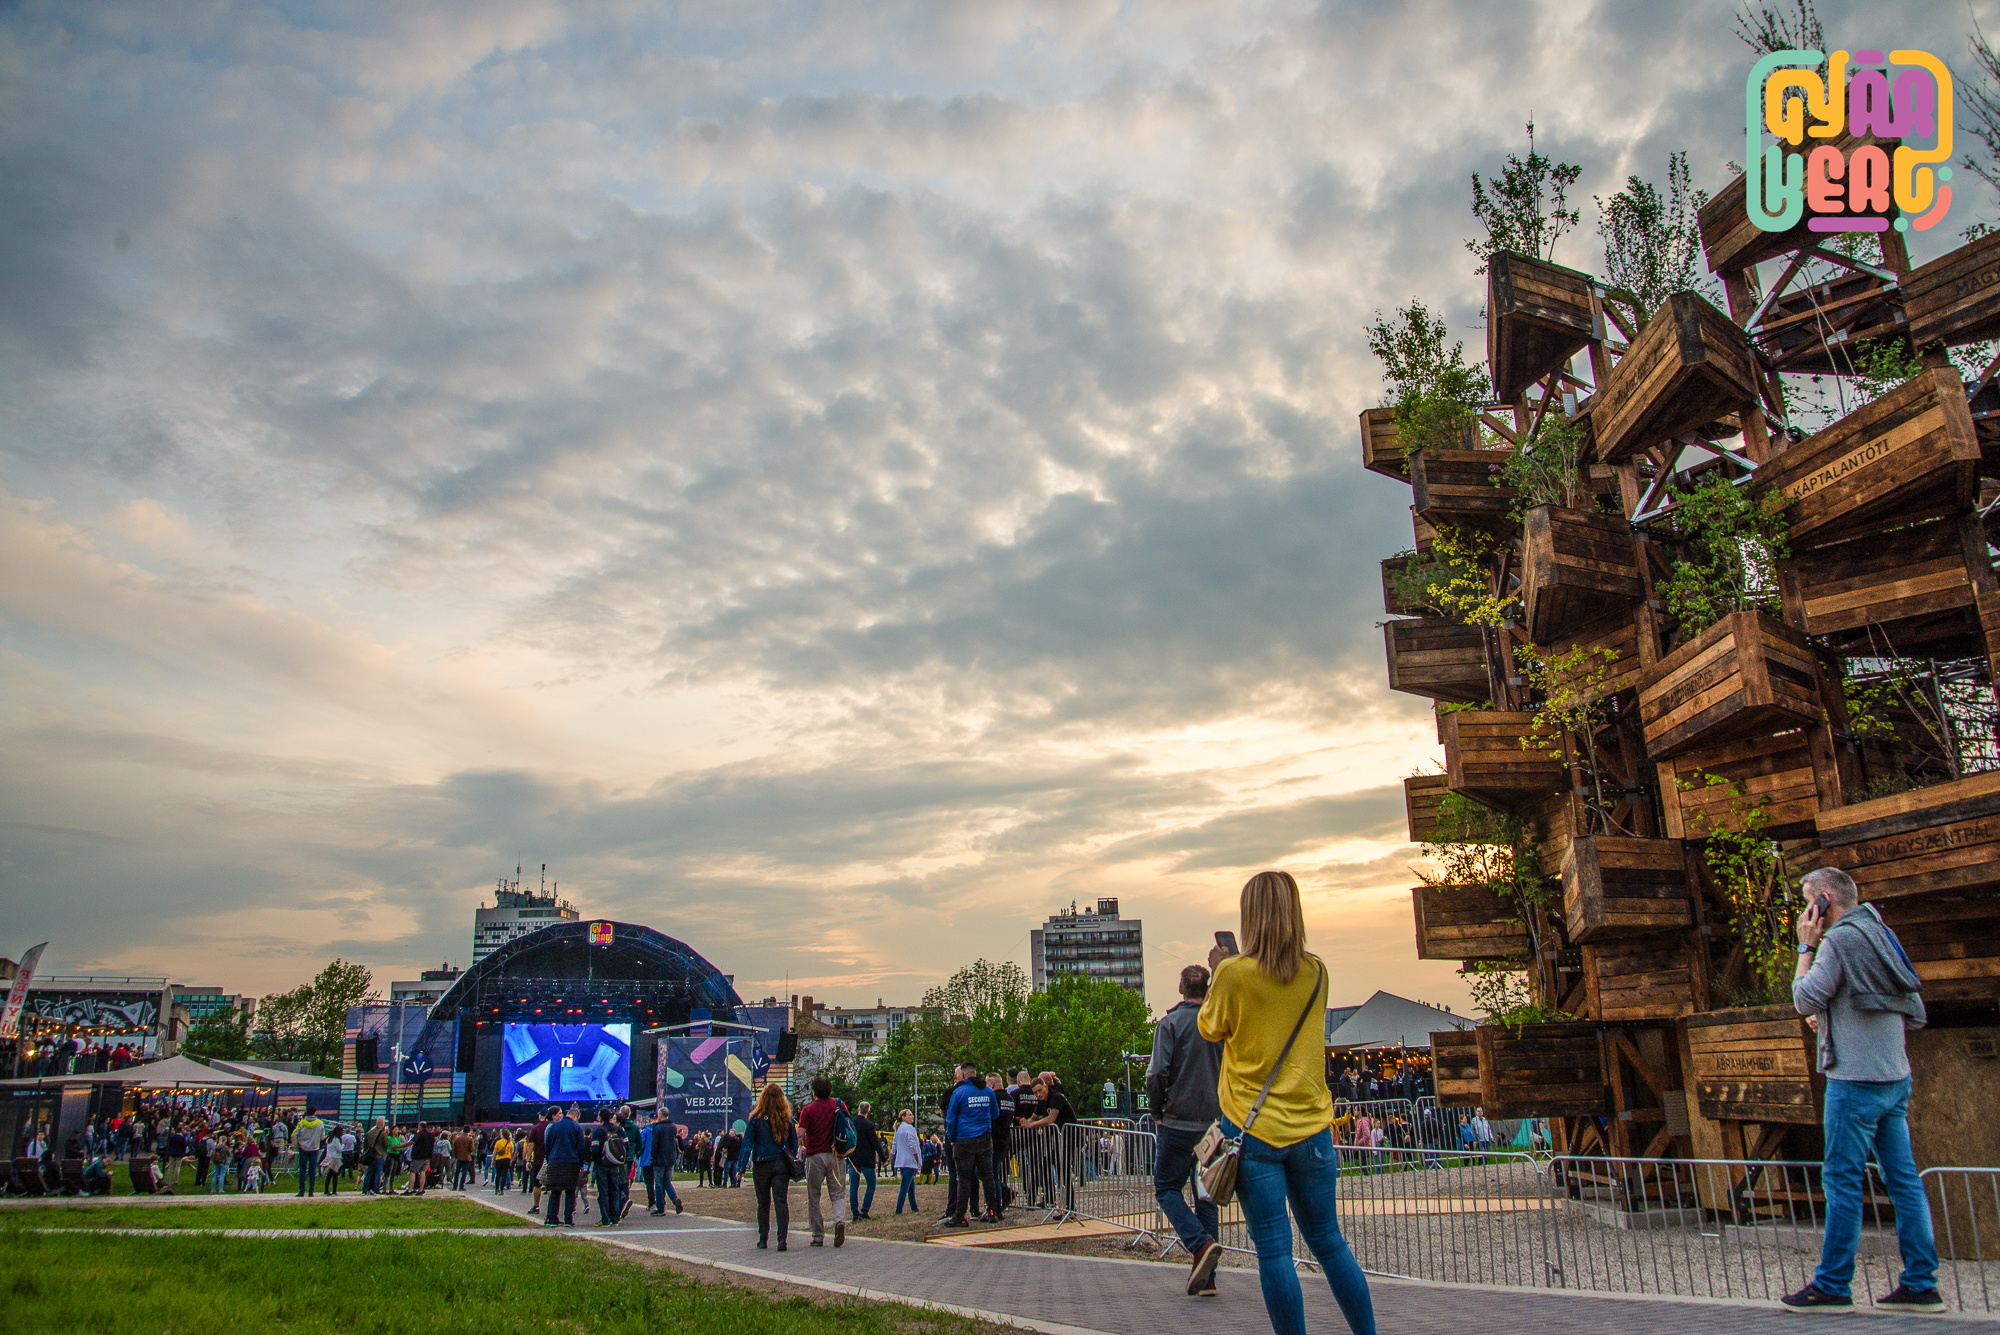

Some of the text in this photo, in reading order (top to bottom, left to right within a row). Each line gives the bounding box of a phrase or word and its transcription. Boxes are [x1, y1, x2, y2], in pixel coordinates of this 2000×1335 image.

[1793, 438, 1890, 497] KÁPTALANTÓTI
[685, 1096, 733, 1107] VEB 2023
